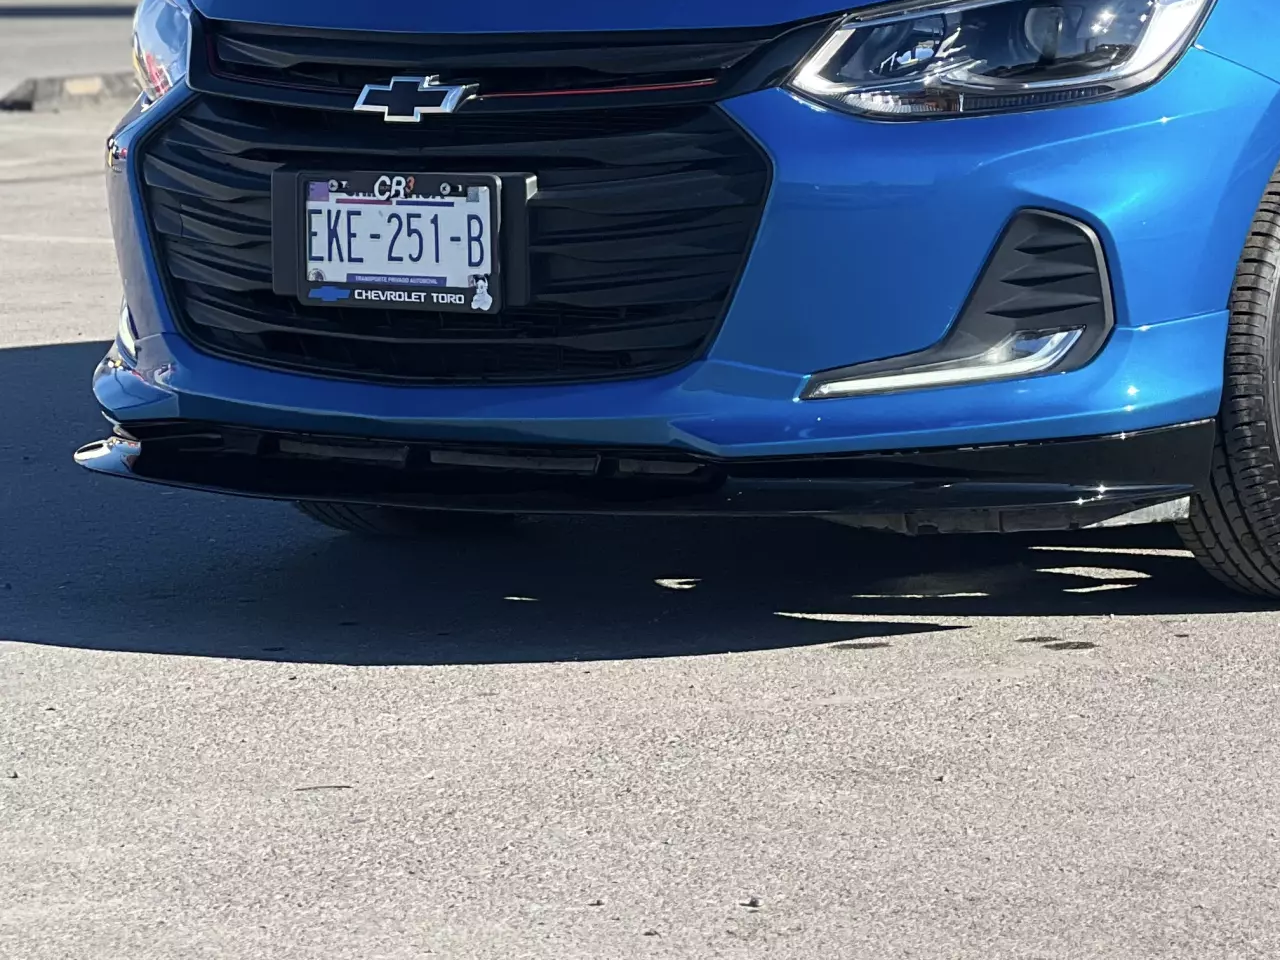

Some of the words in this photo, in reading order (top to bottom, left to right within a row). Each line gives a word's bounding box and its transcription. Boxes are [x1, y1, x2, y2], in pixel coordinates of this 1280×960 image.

[308, 208, 484, 267] EKE-251-B
[354, 289, 427, 303] CHEVROLET
[431, 292, 465, 304] TORO
